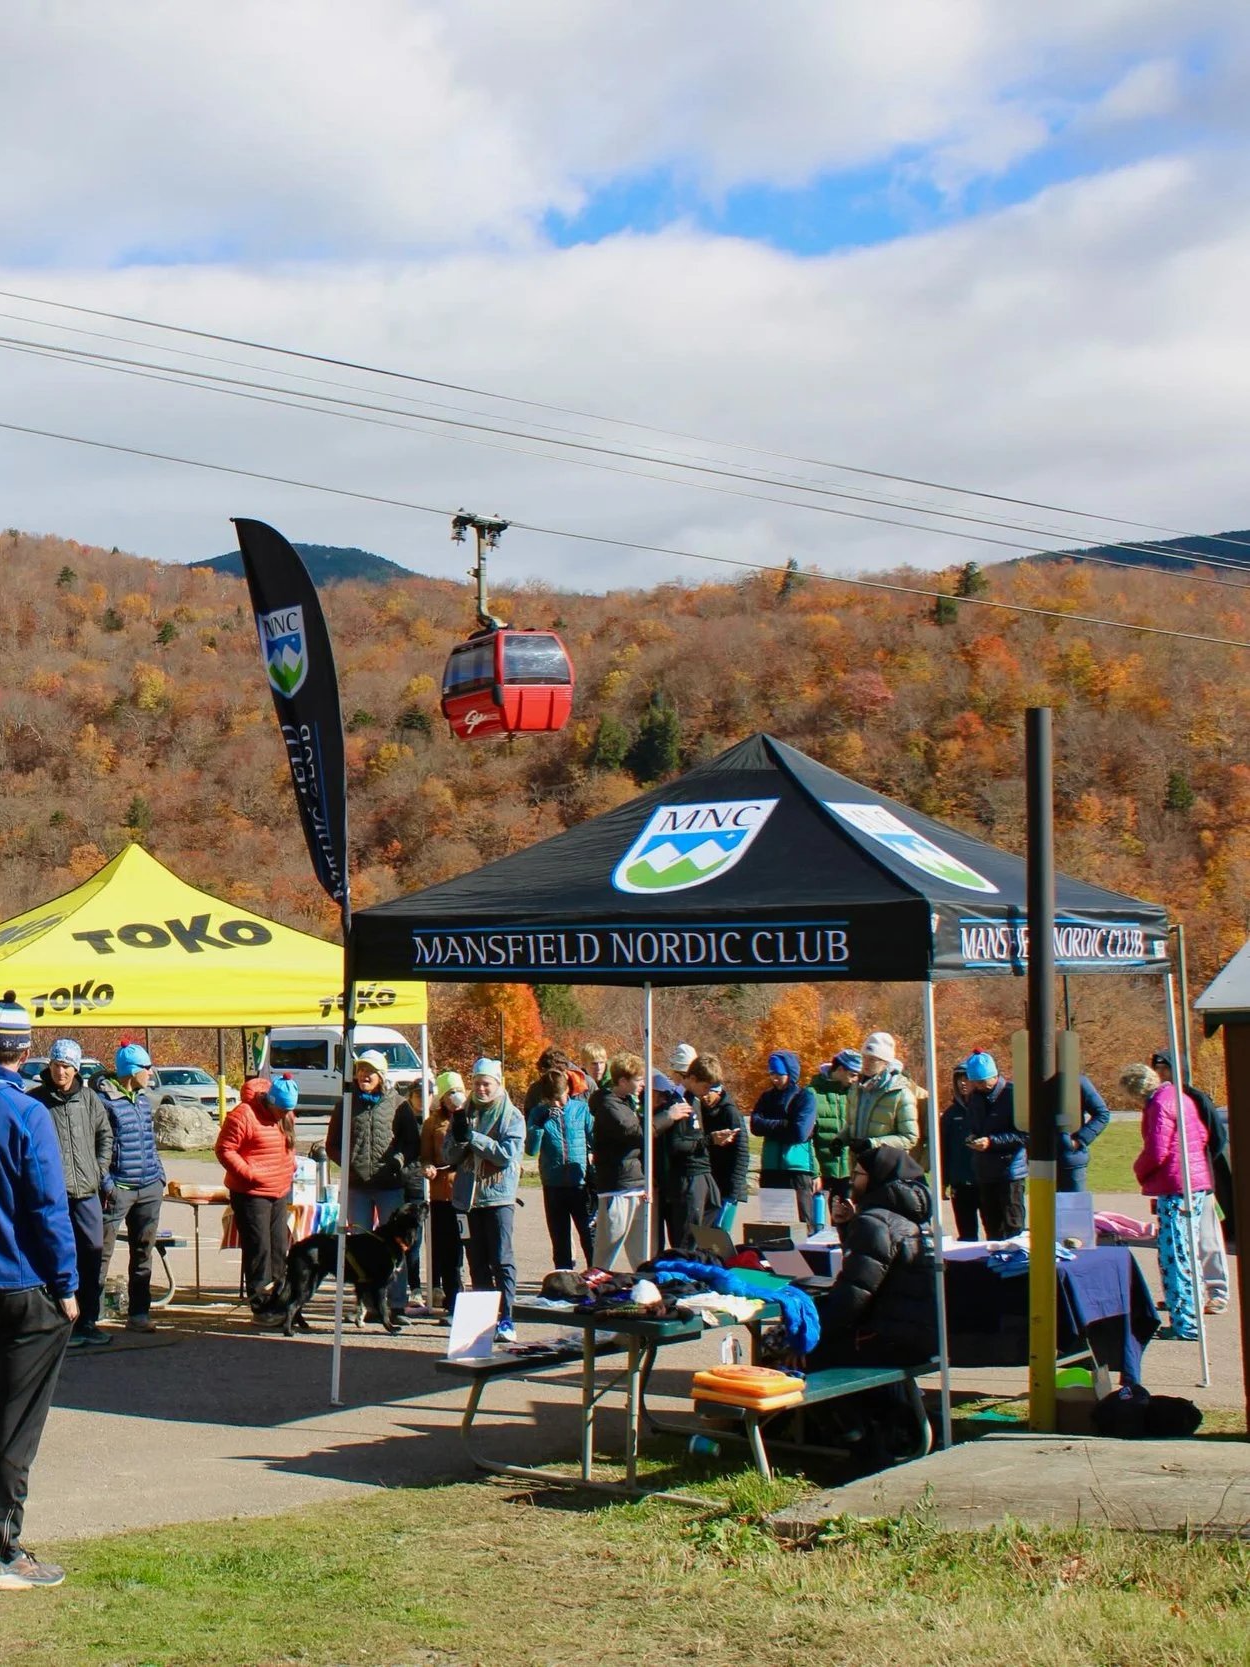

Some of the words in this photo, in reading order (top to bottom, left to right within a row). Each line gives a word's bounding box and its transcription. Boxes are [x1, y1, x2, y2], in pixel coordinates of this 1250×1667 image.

[658, 804, 763, 833] MNC
[72, 913, 273, 955] TOKO
[412, 933, 600, 965] MANSFIELD
[610, 931, 742, 965] NORDIC
[750, 930, 850, 964] CLUB
[960, 926, 1029, 960] MANSFIE
[1053, 926, 1107, 959] NORDIC
[1106, 928, 1145, 959] CLUB
[31, 979, 115, 1018] TOKO
